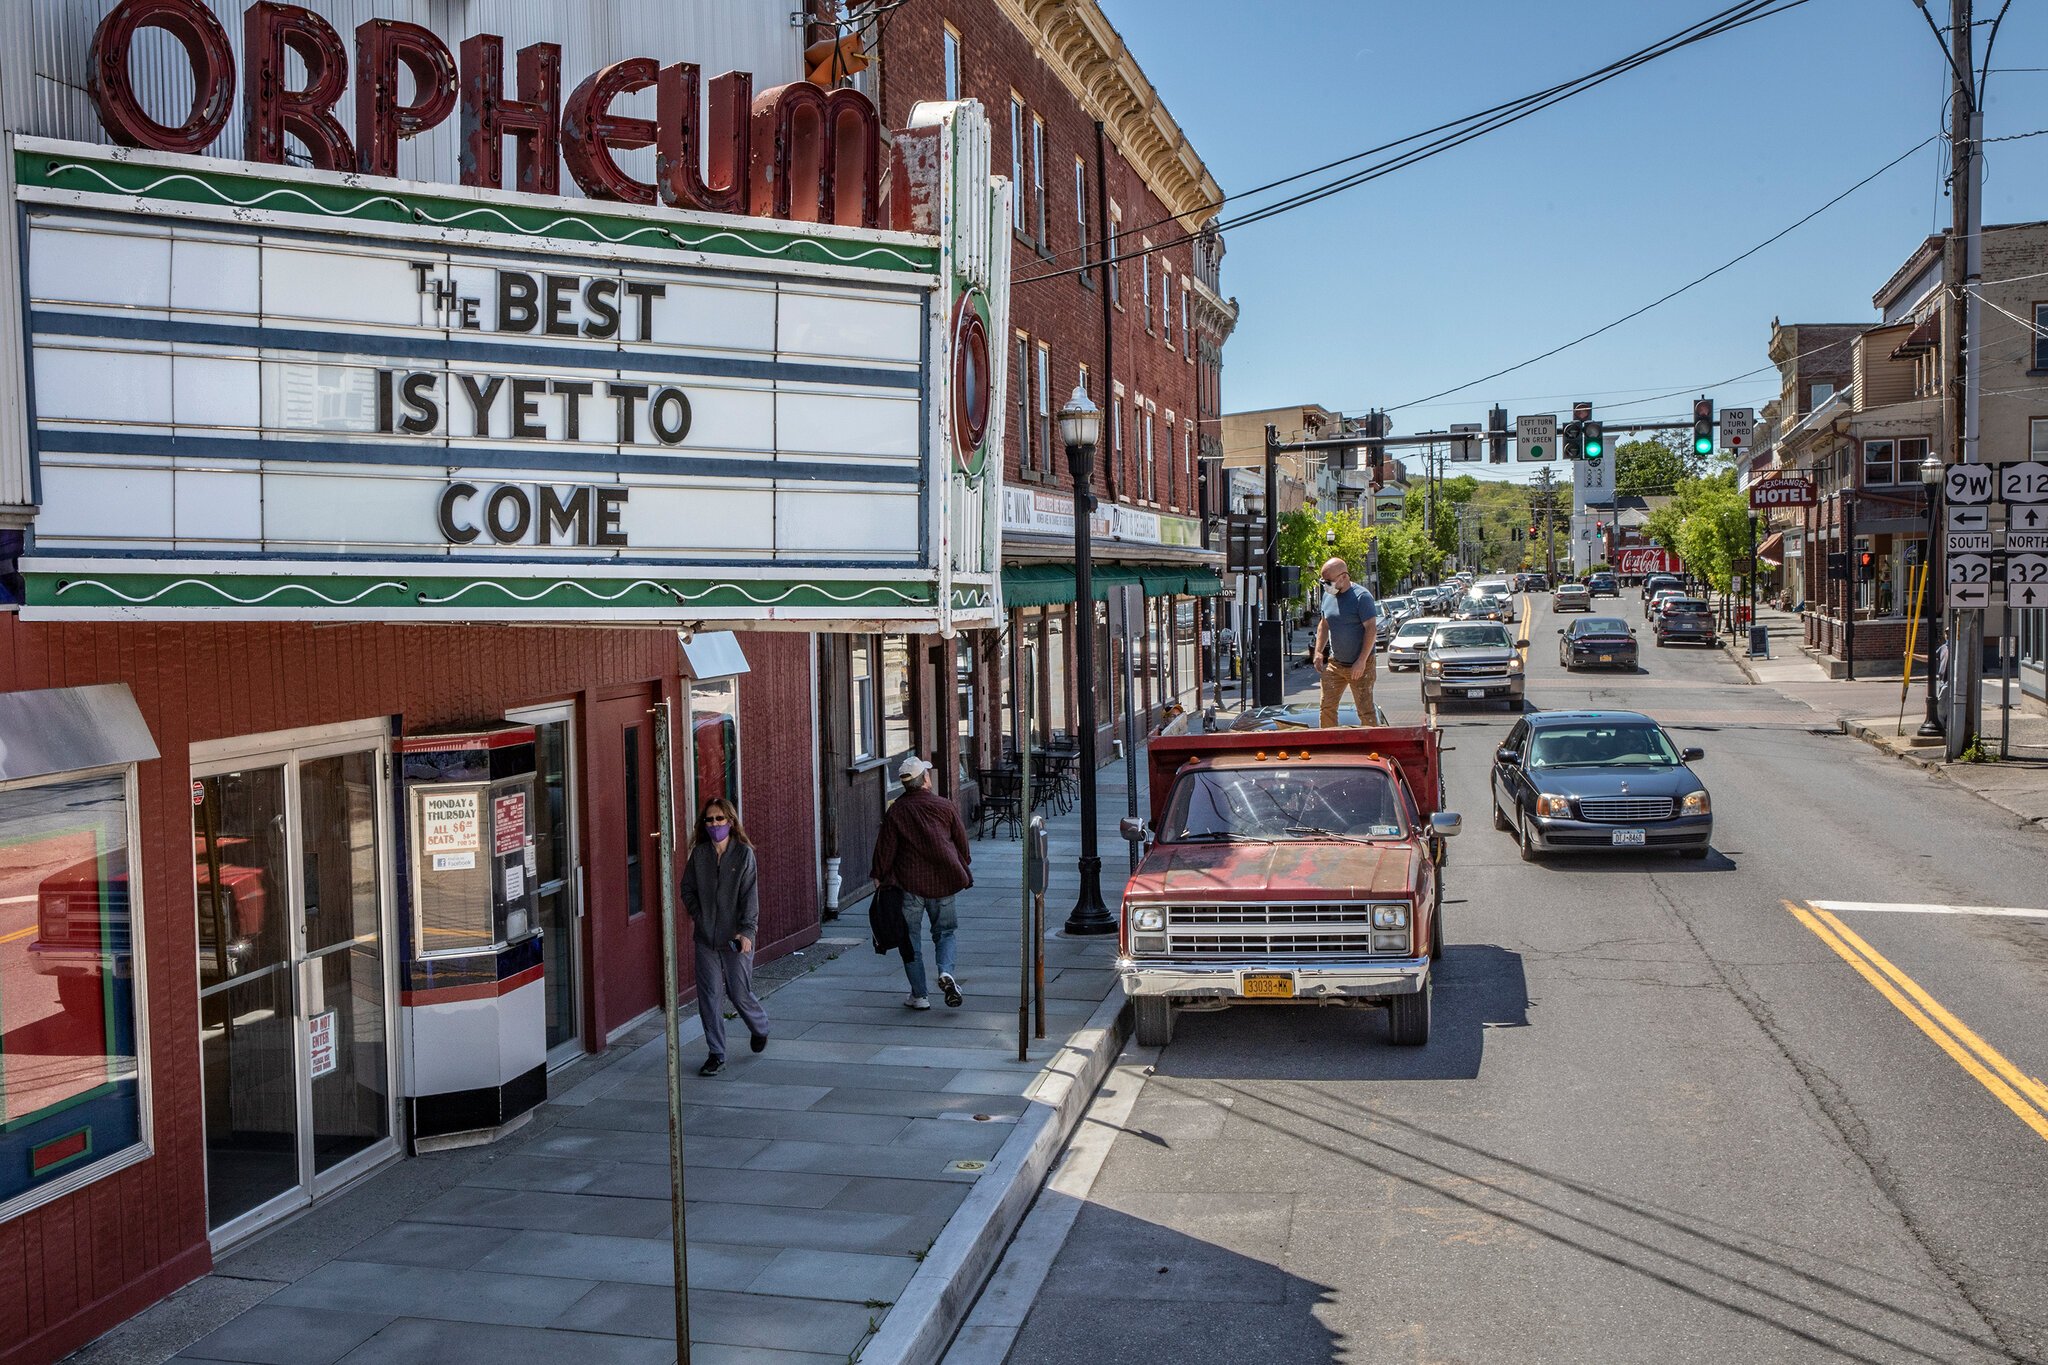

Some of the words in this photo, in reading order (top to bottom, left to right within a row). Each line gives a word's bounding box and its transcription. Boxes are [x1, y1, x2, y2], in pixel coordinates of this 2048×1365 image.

[410, 262, 481, 330] THE
[495, 268, 666, 341] BEST
[375, 370, 439, 435] IS
[455, 374, 594, 441] YET
[606, 382, 692, 446] TO
[1729, 411, 1744, 419] NO
[1526, 427, 1548, 435] YIELD
[1765, 479, 1806, 489] EXCHANGE
[1951, 473, 1988, 496] 9W
[2007, 474, 2048, 494] 212
[1755, 488, 1812, 504] HOTEL
[436, 480, 629, 546] COME
[1950, 536, 1990, 549] SOUTH
[2008, 536, 2048, 549] NORTH
[1951, 563, 1988, 582] 32
[2010, 563, 2048, 582] 32
[429, 799, 466, 809] MONDAY
[427, 810, 476, 821] THURSDAY
[433, 825, 448, 834] ALL
[428, 834, 454, 845] SEATS
[310, 1020, 318, 1034] DO
[320, 1015, 331, 1030] NOT
[312, 1031, 329, 1048] ENTER
